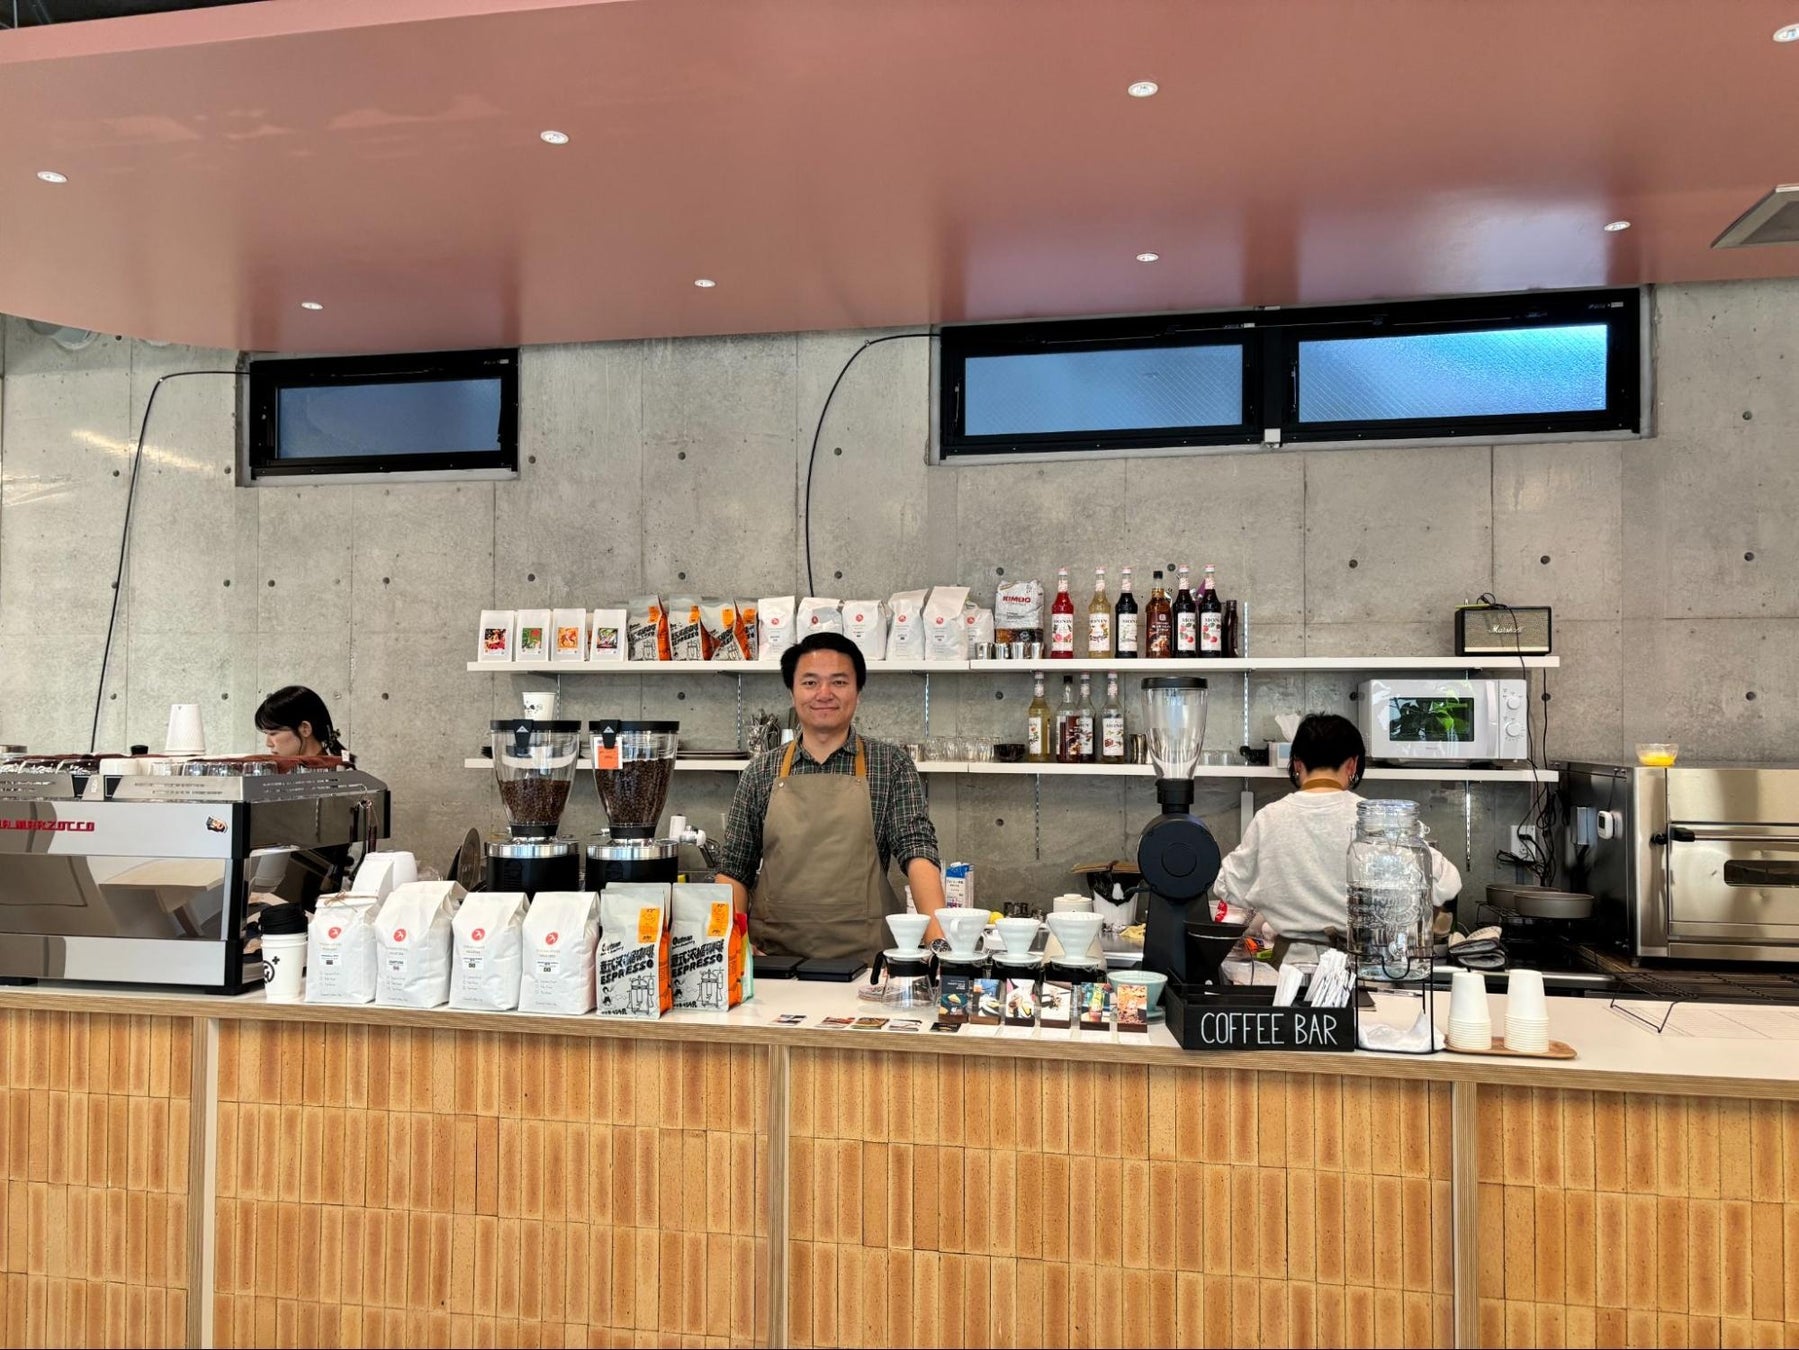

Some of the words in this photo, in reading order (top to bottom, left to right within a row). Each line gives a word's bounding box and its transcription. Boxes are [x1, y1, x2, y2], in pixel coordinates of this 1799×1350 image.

[600, 958, 654, 985] ESPRESSO
[670, 953, 723, 978] ESPRESSO
[1200, 1012, 1285, 1045] COFFEE
[1294, 1013, 1338, 1046] BAR
